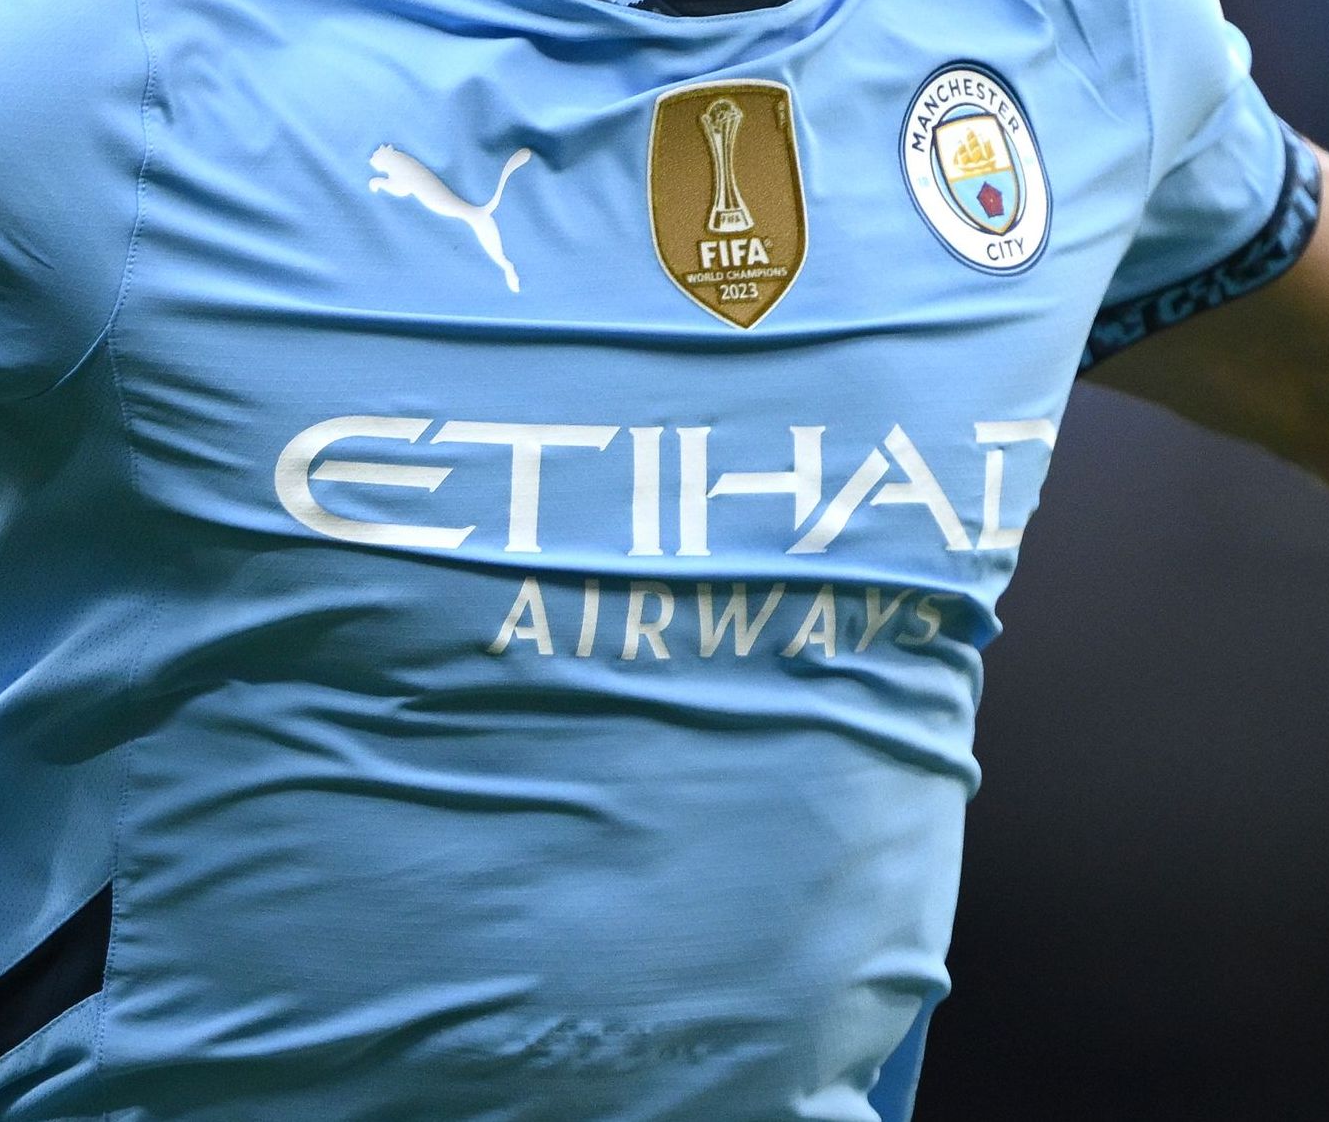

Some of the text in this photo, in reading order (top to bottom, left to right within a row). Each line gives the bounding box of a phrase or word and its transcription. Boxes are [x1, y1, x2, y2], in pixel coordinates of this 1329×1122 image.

[911, 77, 1020, 152] MANCHESTER
[700, 237, 770, 269] FIFA
[986, 237, 1025, 261] CITY
[686, 266, 788, 284] WORLD CHAMPIONS
[720, 282, 759, 300] 2023
[274, 416, 1057, 556] ETIHAD
[487, 575, 964, 661] AIRWAYS
